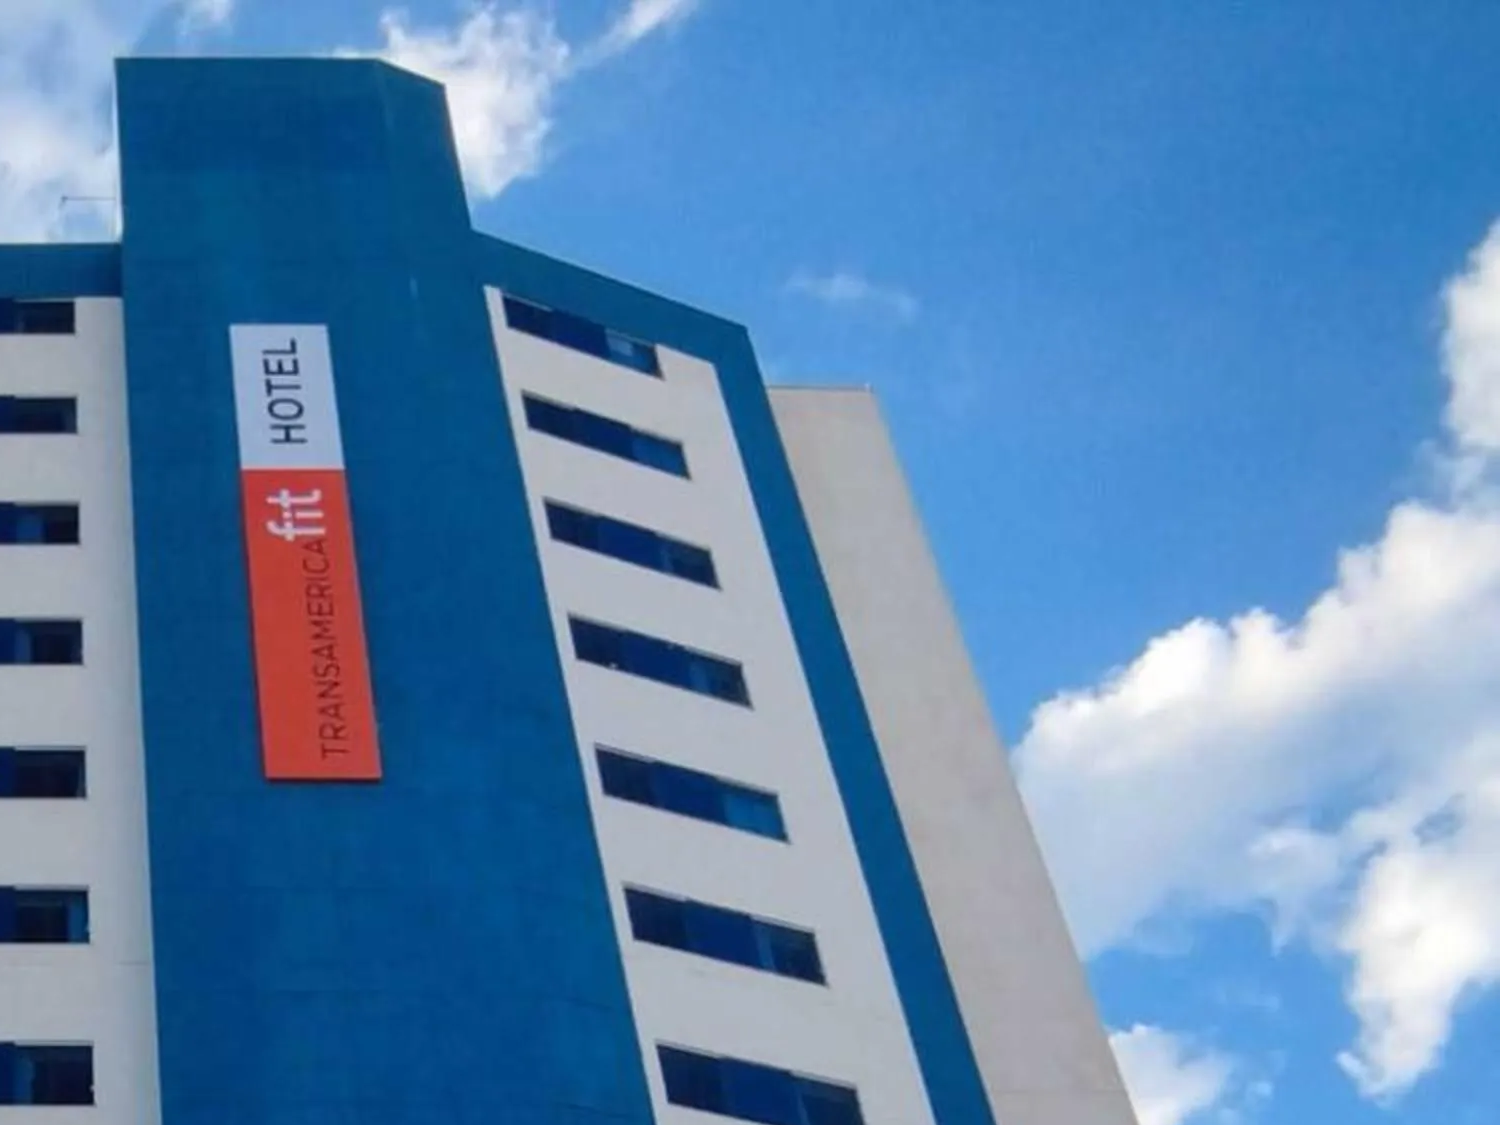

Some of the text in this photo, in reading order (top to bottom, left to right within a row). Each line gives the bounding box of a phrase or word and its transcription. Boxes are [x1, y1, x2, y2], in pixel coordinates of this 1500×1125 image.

[263, 338, 350, 761] TRANSAMERICA fit HOTEL
